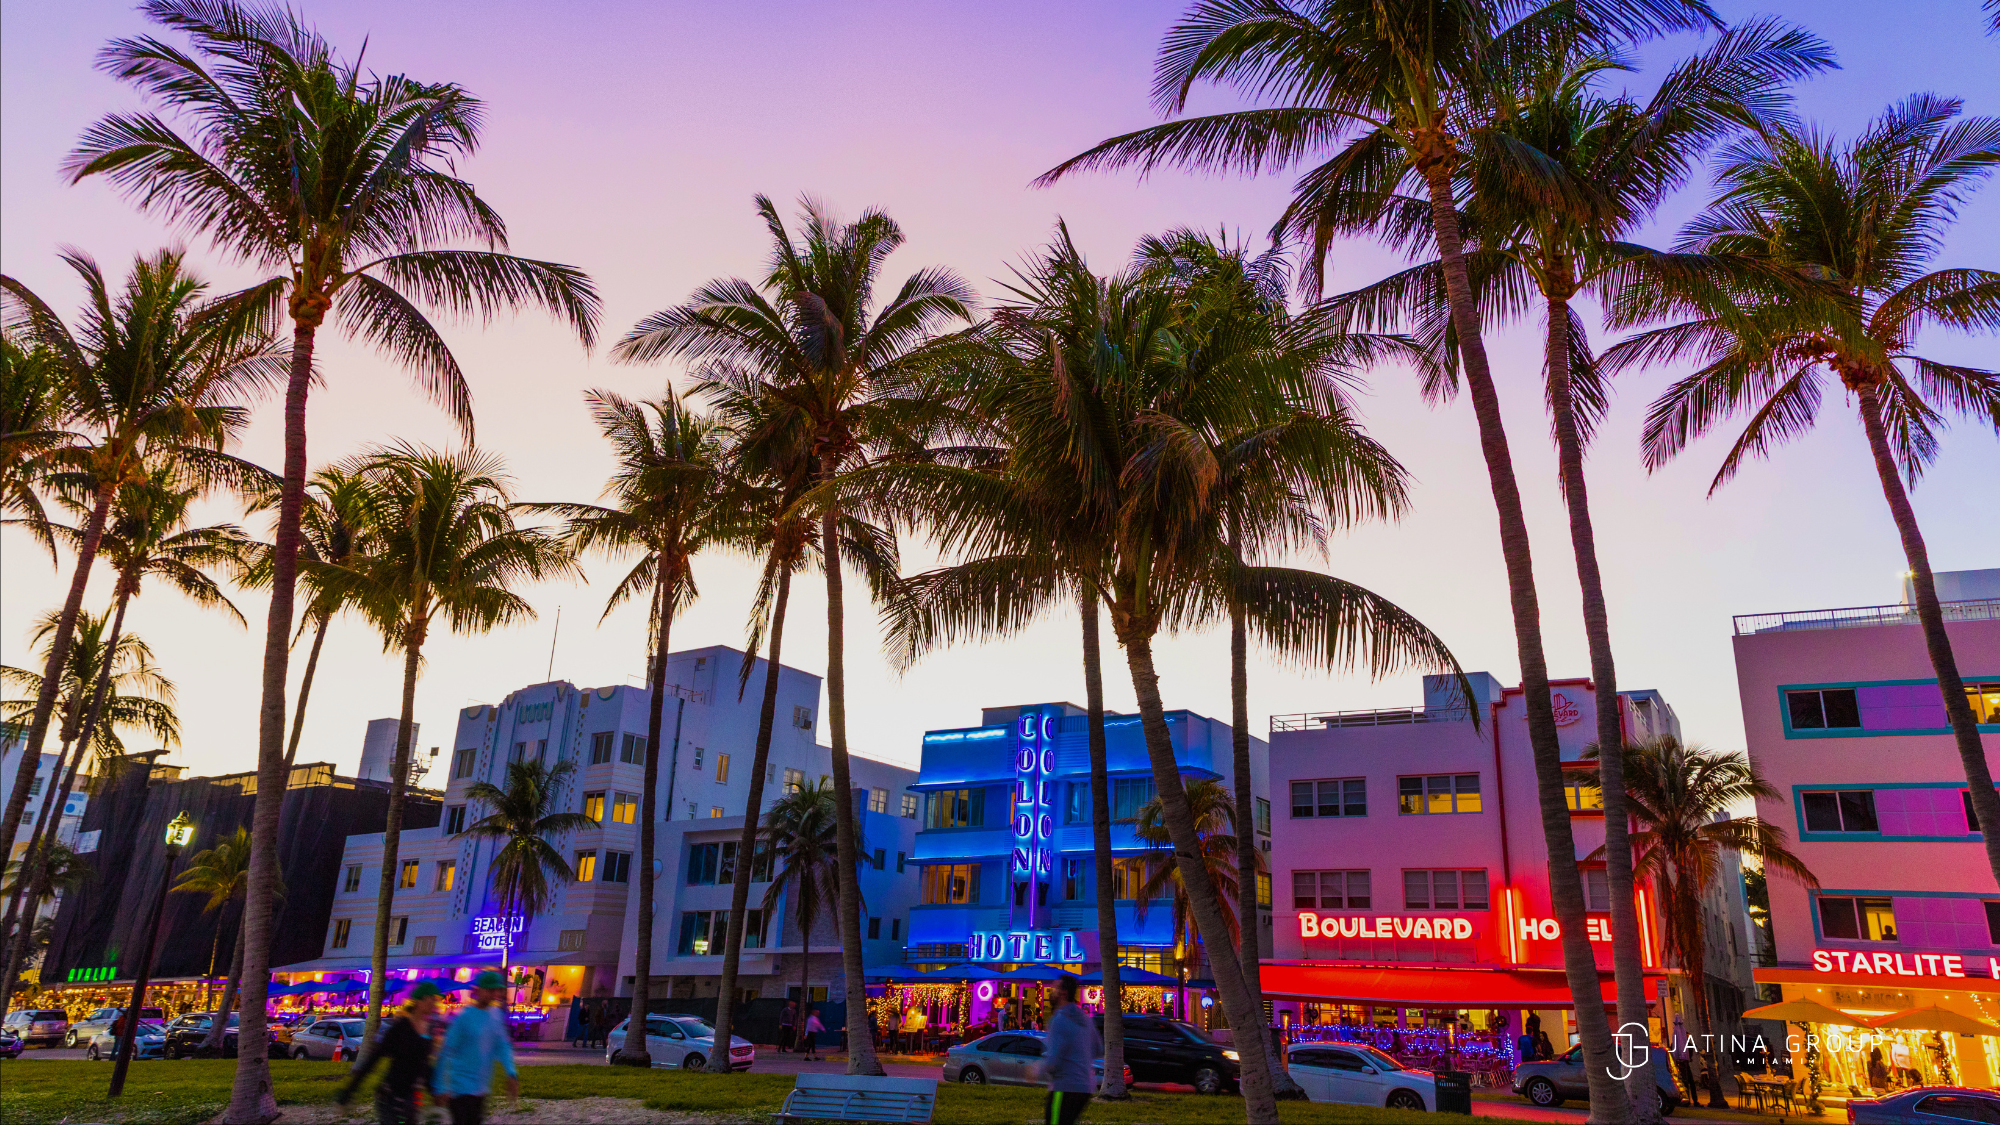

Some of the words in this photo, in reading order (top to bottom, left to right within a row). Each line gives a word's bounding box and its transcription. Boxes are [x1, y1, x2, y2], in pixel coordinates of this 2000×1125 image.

[1012, 715, 1035, 906] COLONY
[1038, 717, 1055, 906] COLONY
[472, 917, 524, 934] BEACN
[1299, 912, 1472, 939] BOULEVARD
[1520, 918, 1612, 942] HOEL
[968, 933, 1082, 960] HOTEL
[1813, 950, 1965, 977] STARLITE
